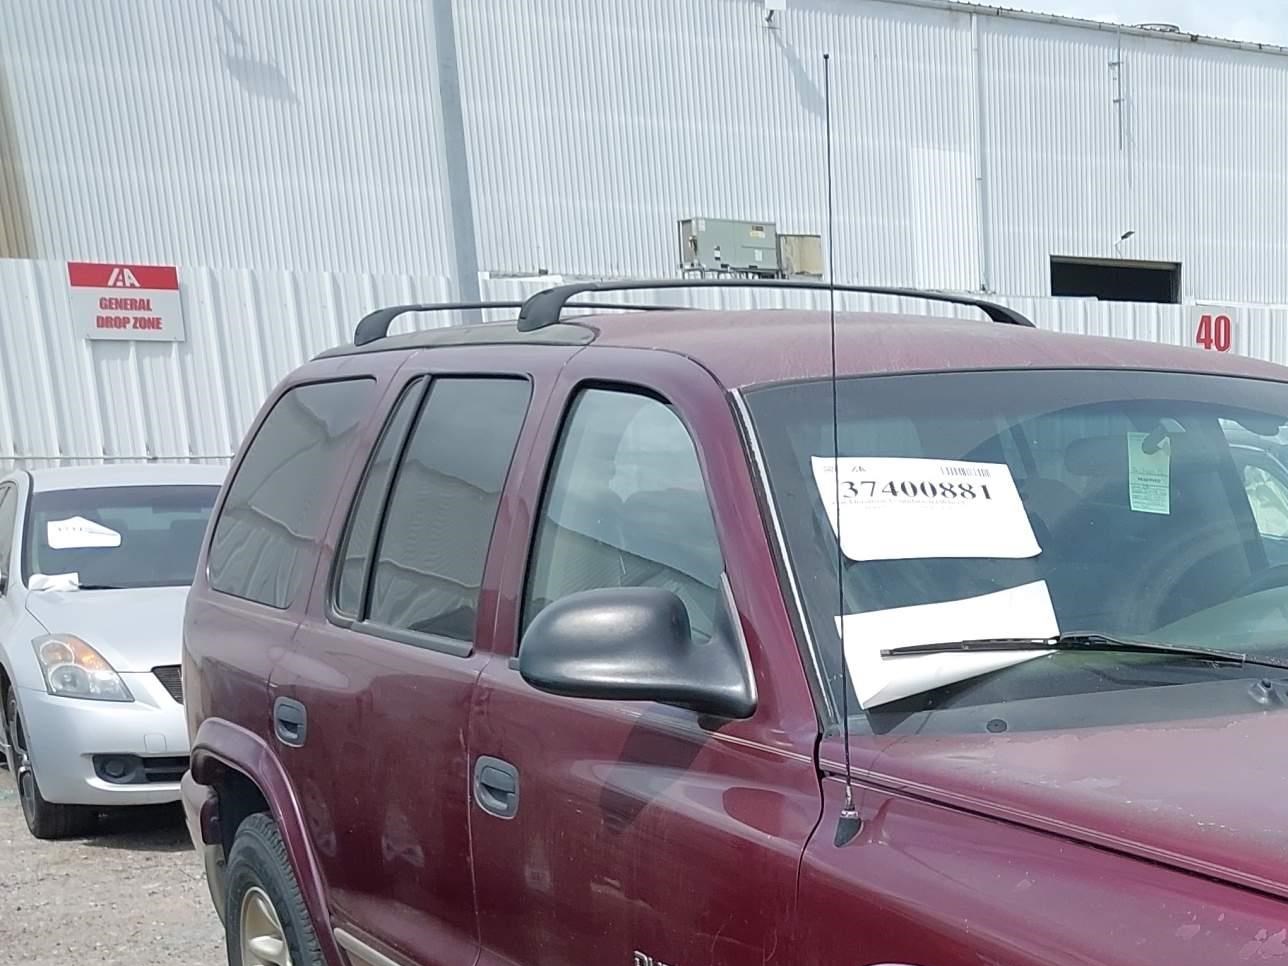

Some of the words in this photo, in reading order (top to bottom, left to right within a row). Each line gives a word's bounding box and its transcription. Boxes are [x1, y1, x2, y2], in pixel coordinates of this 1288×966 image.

[99, 297, 153, 312] GENERAL
[96, 315, 131, 329] DROP
[132, 316, 163, 330] ZONE
[1195, 314, 1231, 352] 40
[841, 480, 993, 500] 37400881
